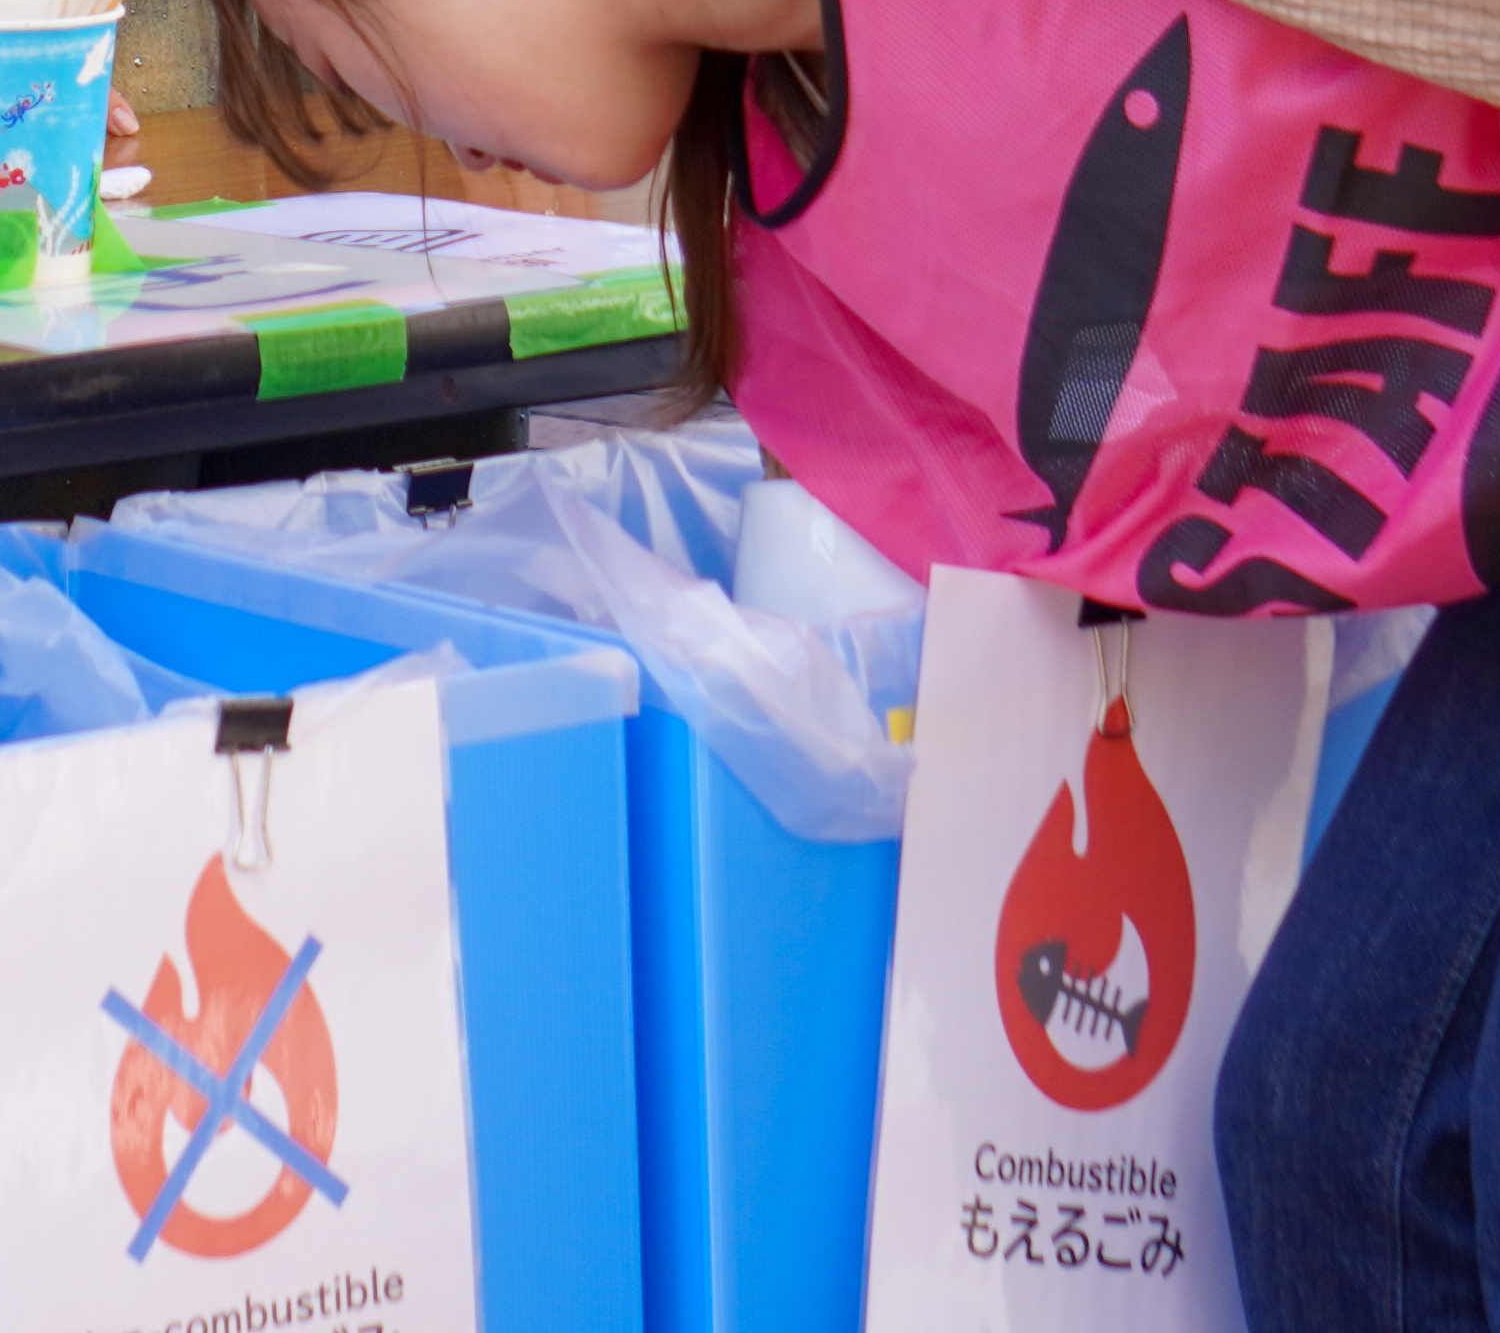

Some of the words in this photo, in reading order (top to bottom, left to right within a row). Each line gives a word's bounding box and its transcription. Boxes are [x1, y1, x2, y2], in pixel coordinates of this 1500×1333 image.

[974, 1142, 1178, 1199] Combustible
[960, 1194, 1185, 1278] もえるごみ
